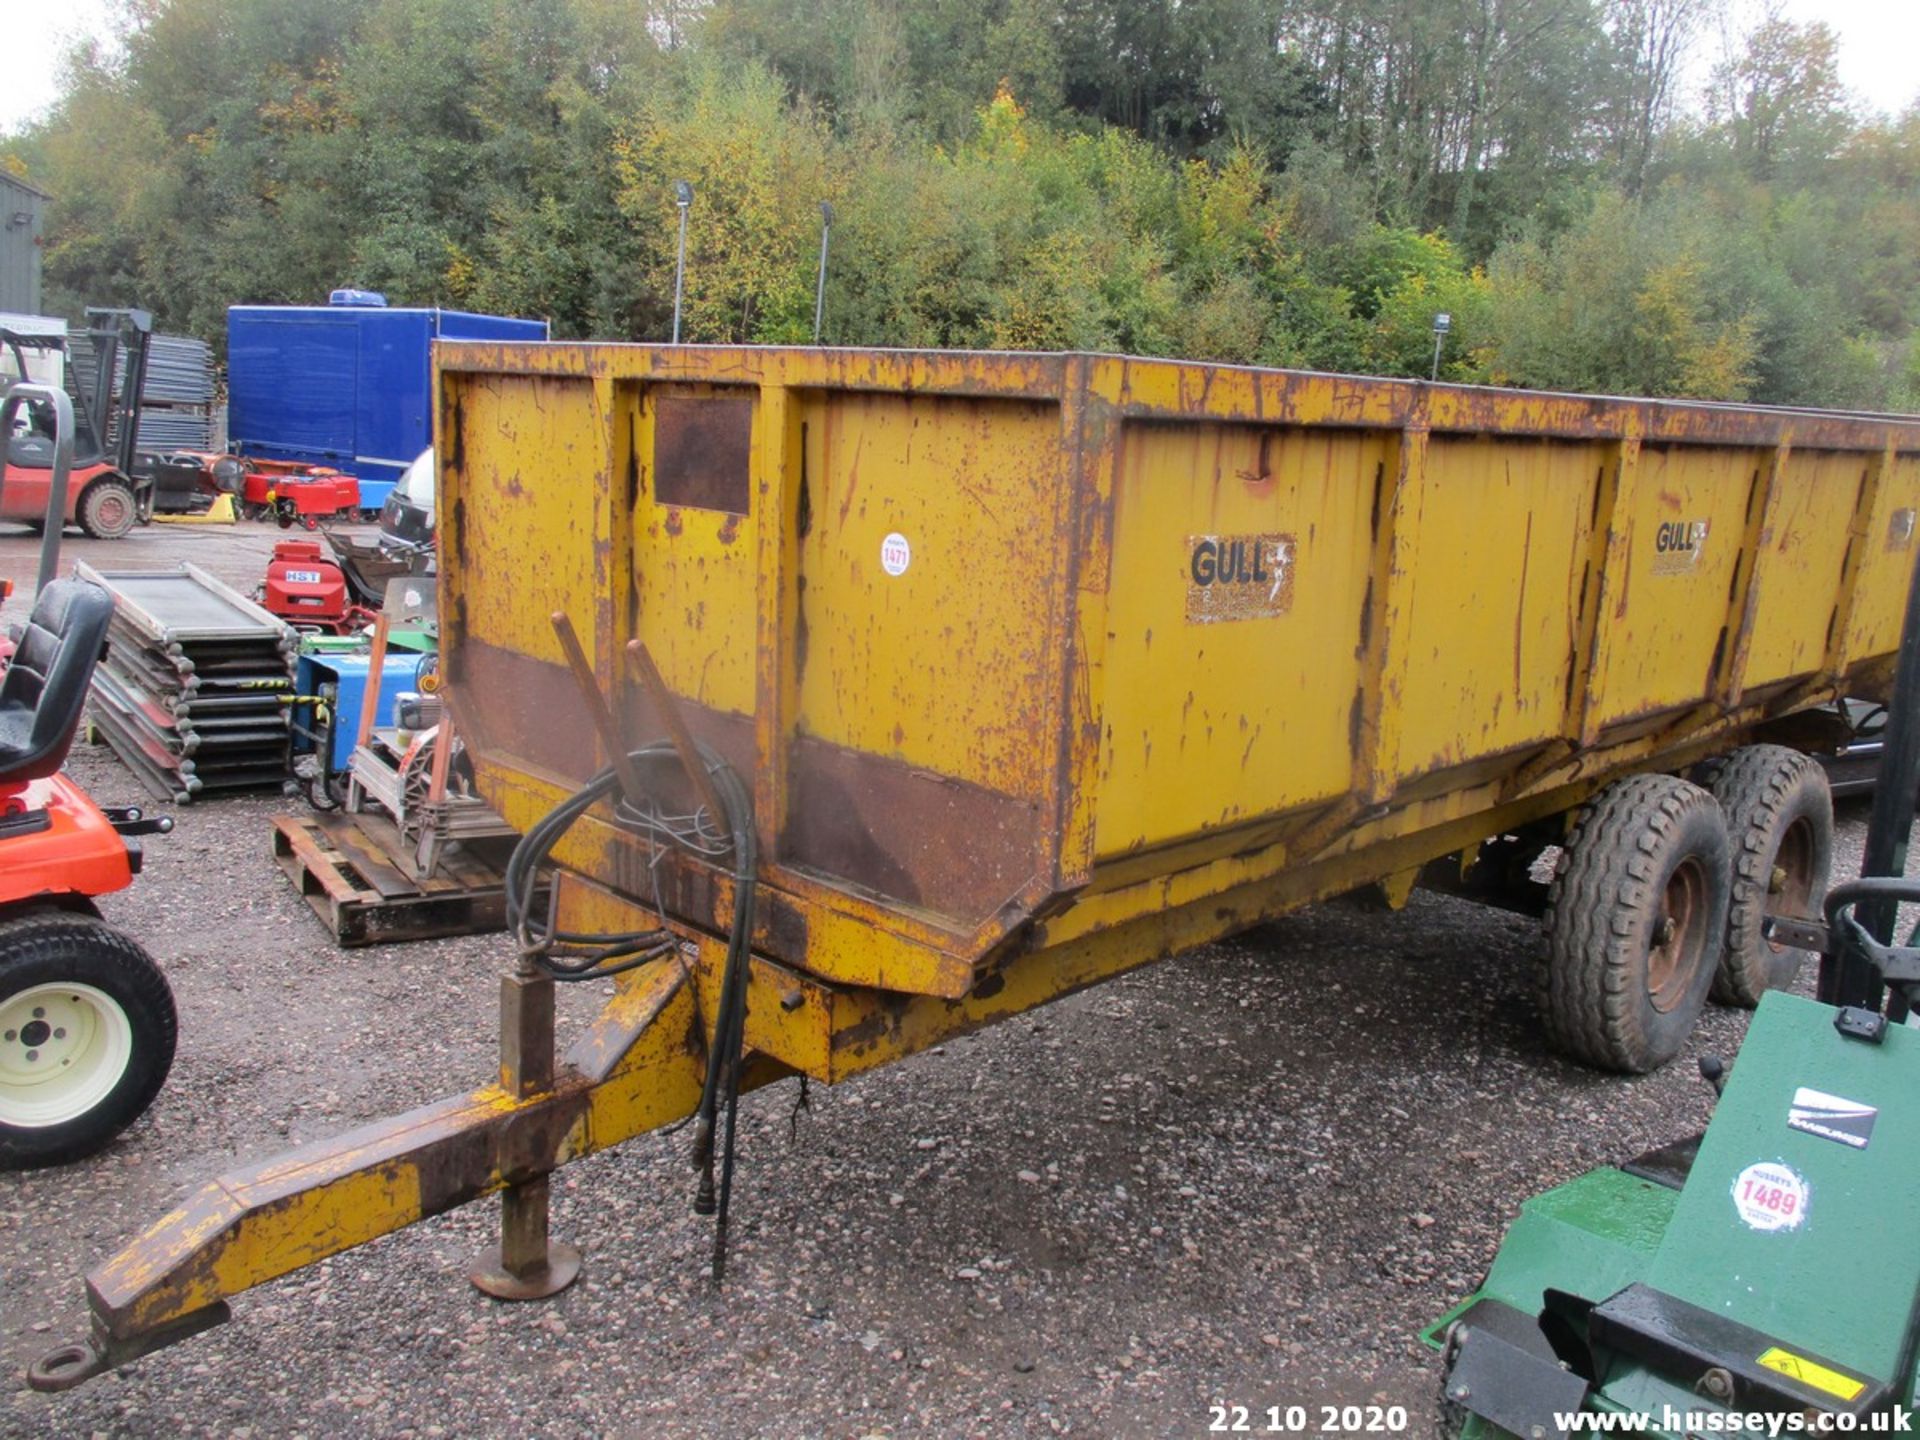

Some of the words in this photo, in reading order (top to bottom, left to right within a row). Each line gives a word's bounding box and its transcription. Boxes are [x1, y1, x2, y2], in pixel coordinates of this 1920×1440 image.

[1655, 521, 1694, 553] GULL
[884, 548, 907, 566] 1471
[1191, 540, 1268, 587] GULL
[287, 572, 318, 582] HST
[1743, 1180, 1797, 1216] 1489
